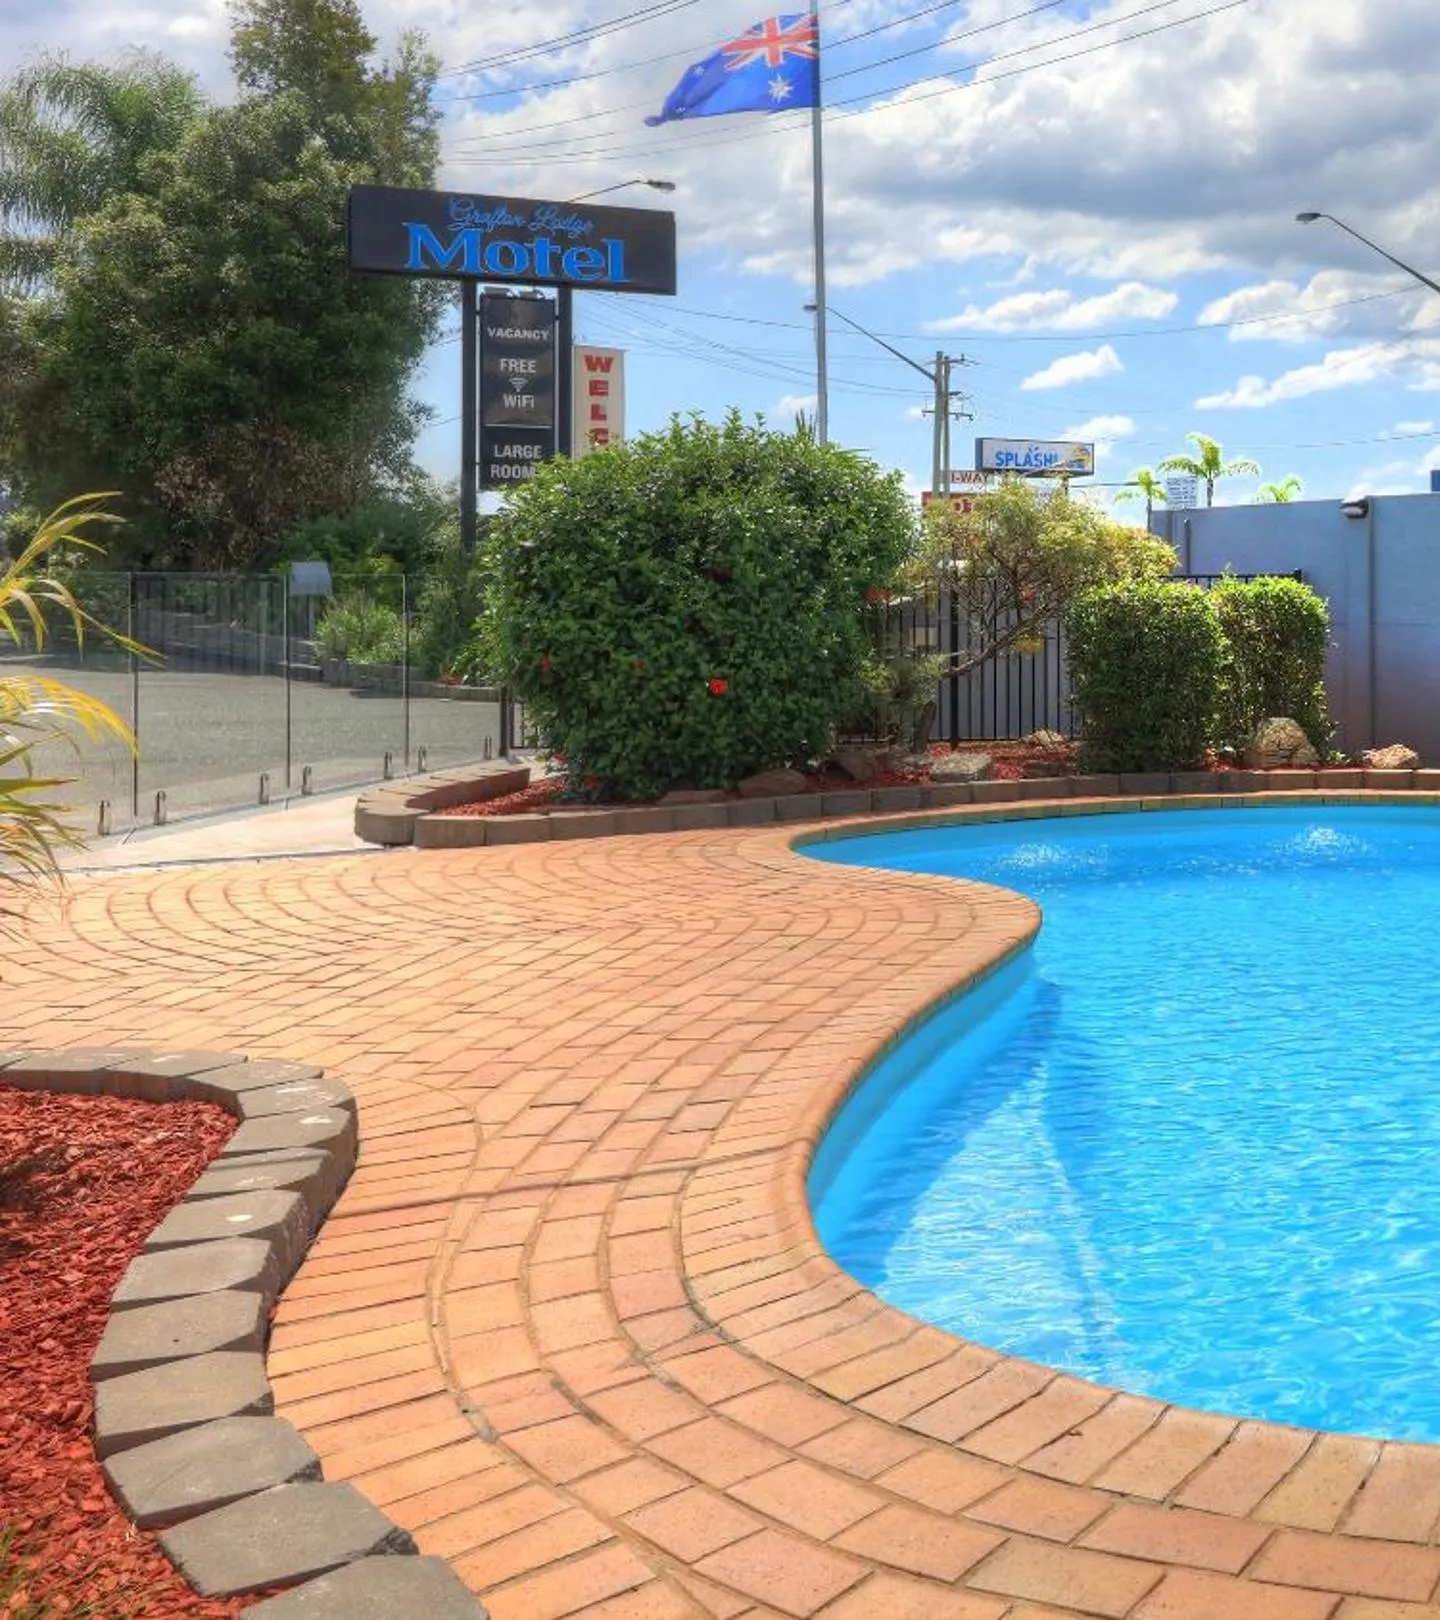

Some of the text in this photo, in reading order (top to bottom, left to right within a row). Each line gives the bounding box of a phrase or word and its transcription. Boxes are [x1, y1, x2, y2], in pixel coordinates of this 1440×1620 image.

[401, 222, 631, 283] Motel
[487, 326, 550, 341] VACANCY
[500, 359, 537, 374] FREE
[503, 394, 535, 409] WiFi
[494, 444, 542, 460] LARGE
[490, 464, 536, 480] ROOM
[949, 471, 989, 484] I-WAY
